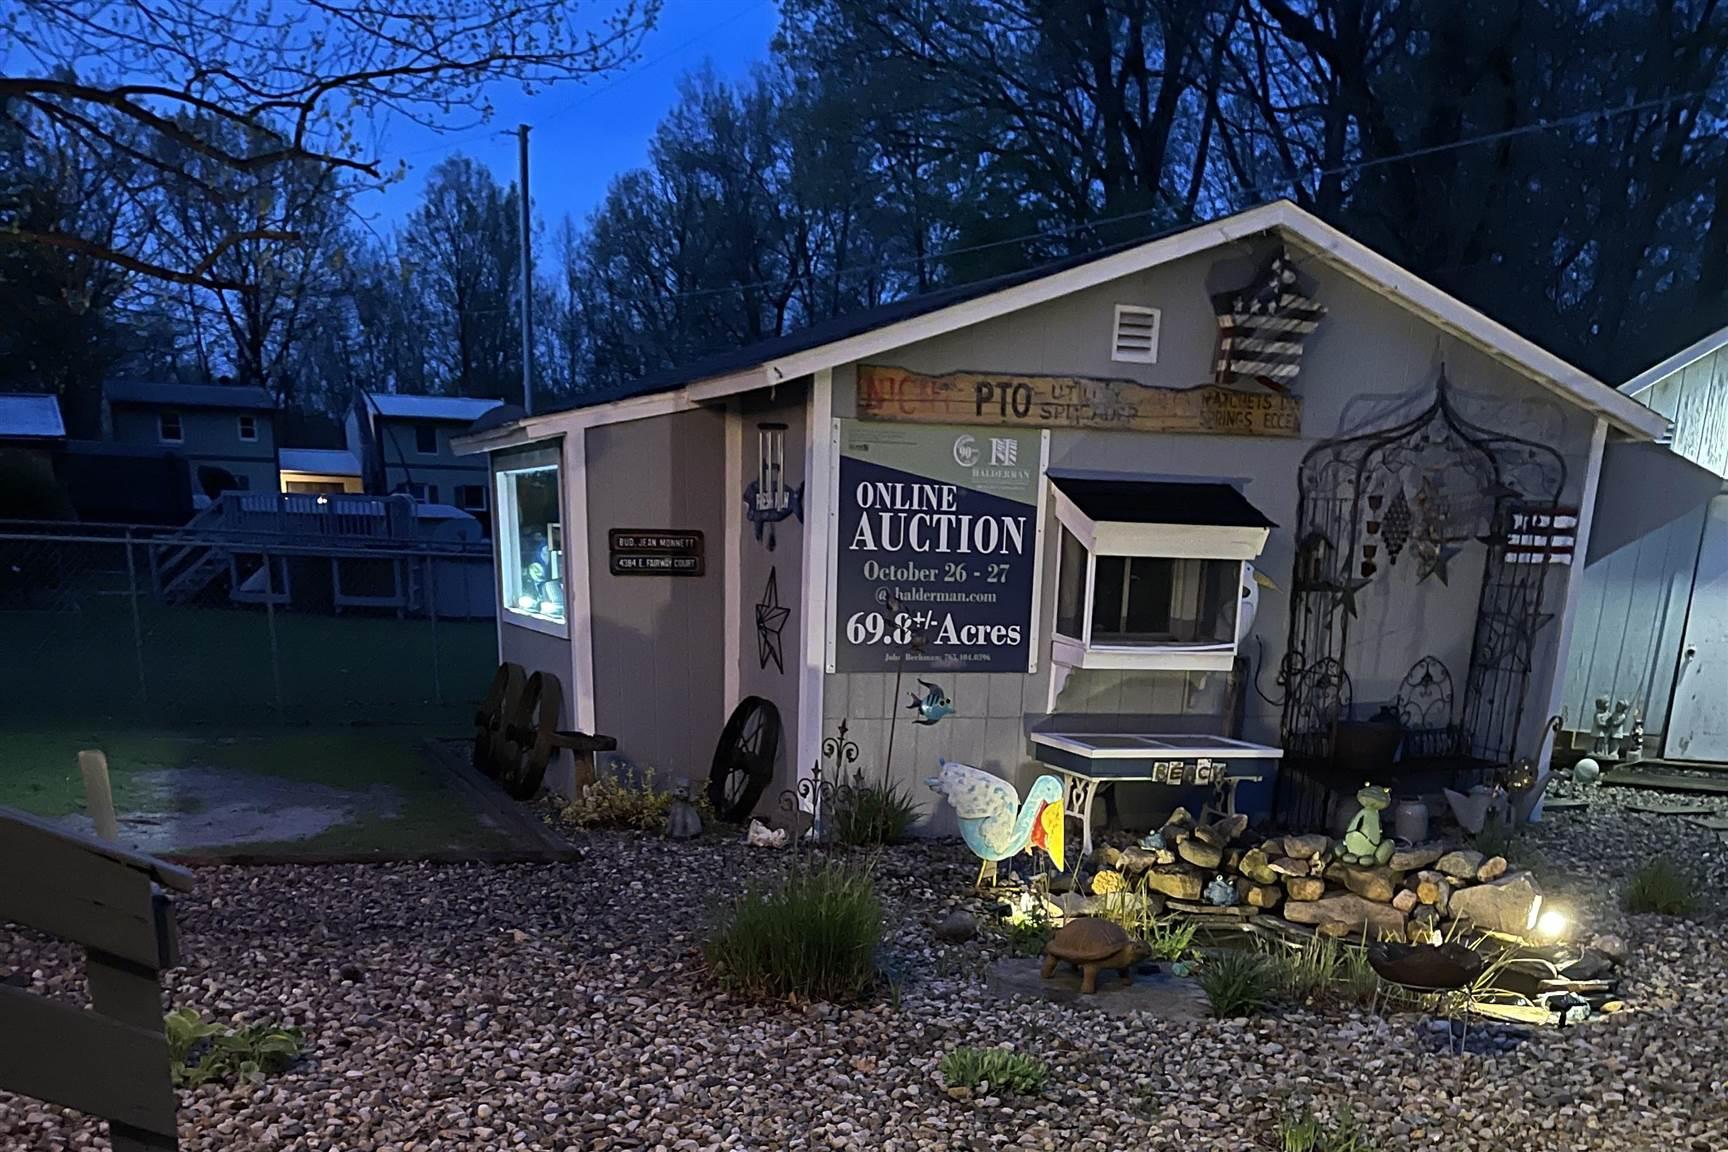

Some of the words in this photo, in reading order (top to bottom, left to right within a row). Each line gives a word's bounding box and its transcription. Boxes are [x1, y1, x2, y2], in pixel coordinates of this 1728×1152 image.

[975, 381, 1032, 418] PTO
[972, 468, 1030, 479] HALDERMAN
[857, 481, 957, 511] ONLINE
[638, 538, 656, 547] JEAN
[849, 511, 1026, 554] AUCTION
[646, 558, 672, 568] FAIRWAY
[674, 559, 695, 568] COURT
[864, 560, 938, 581] October
[944, 563, 967, 582] 26
[987, 564, 1010, 583] 27
[895, 587, 996, 603] halderman.com
[934, 613, 1021, 645] Acres
